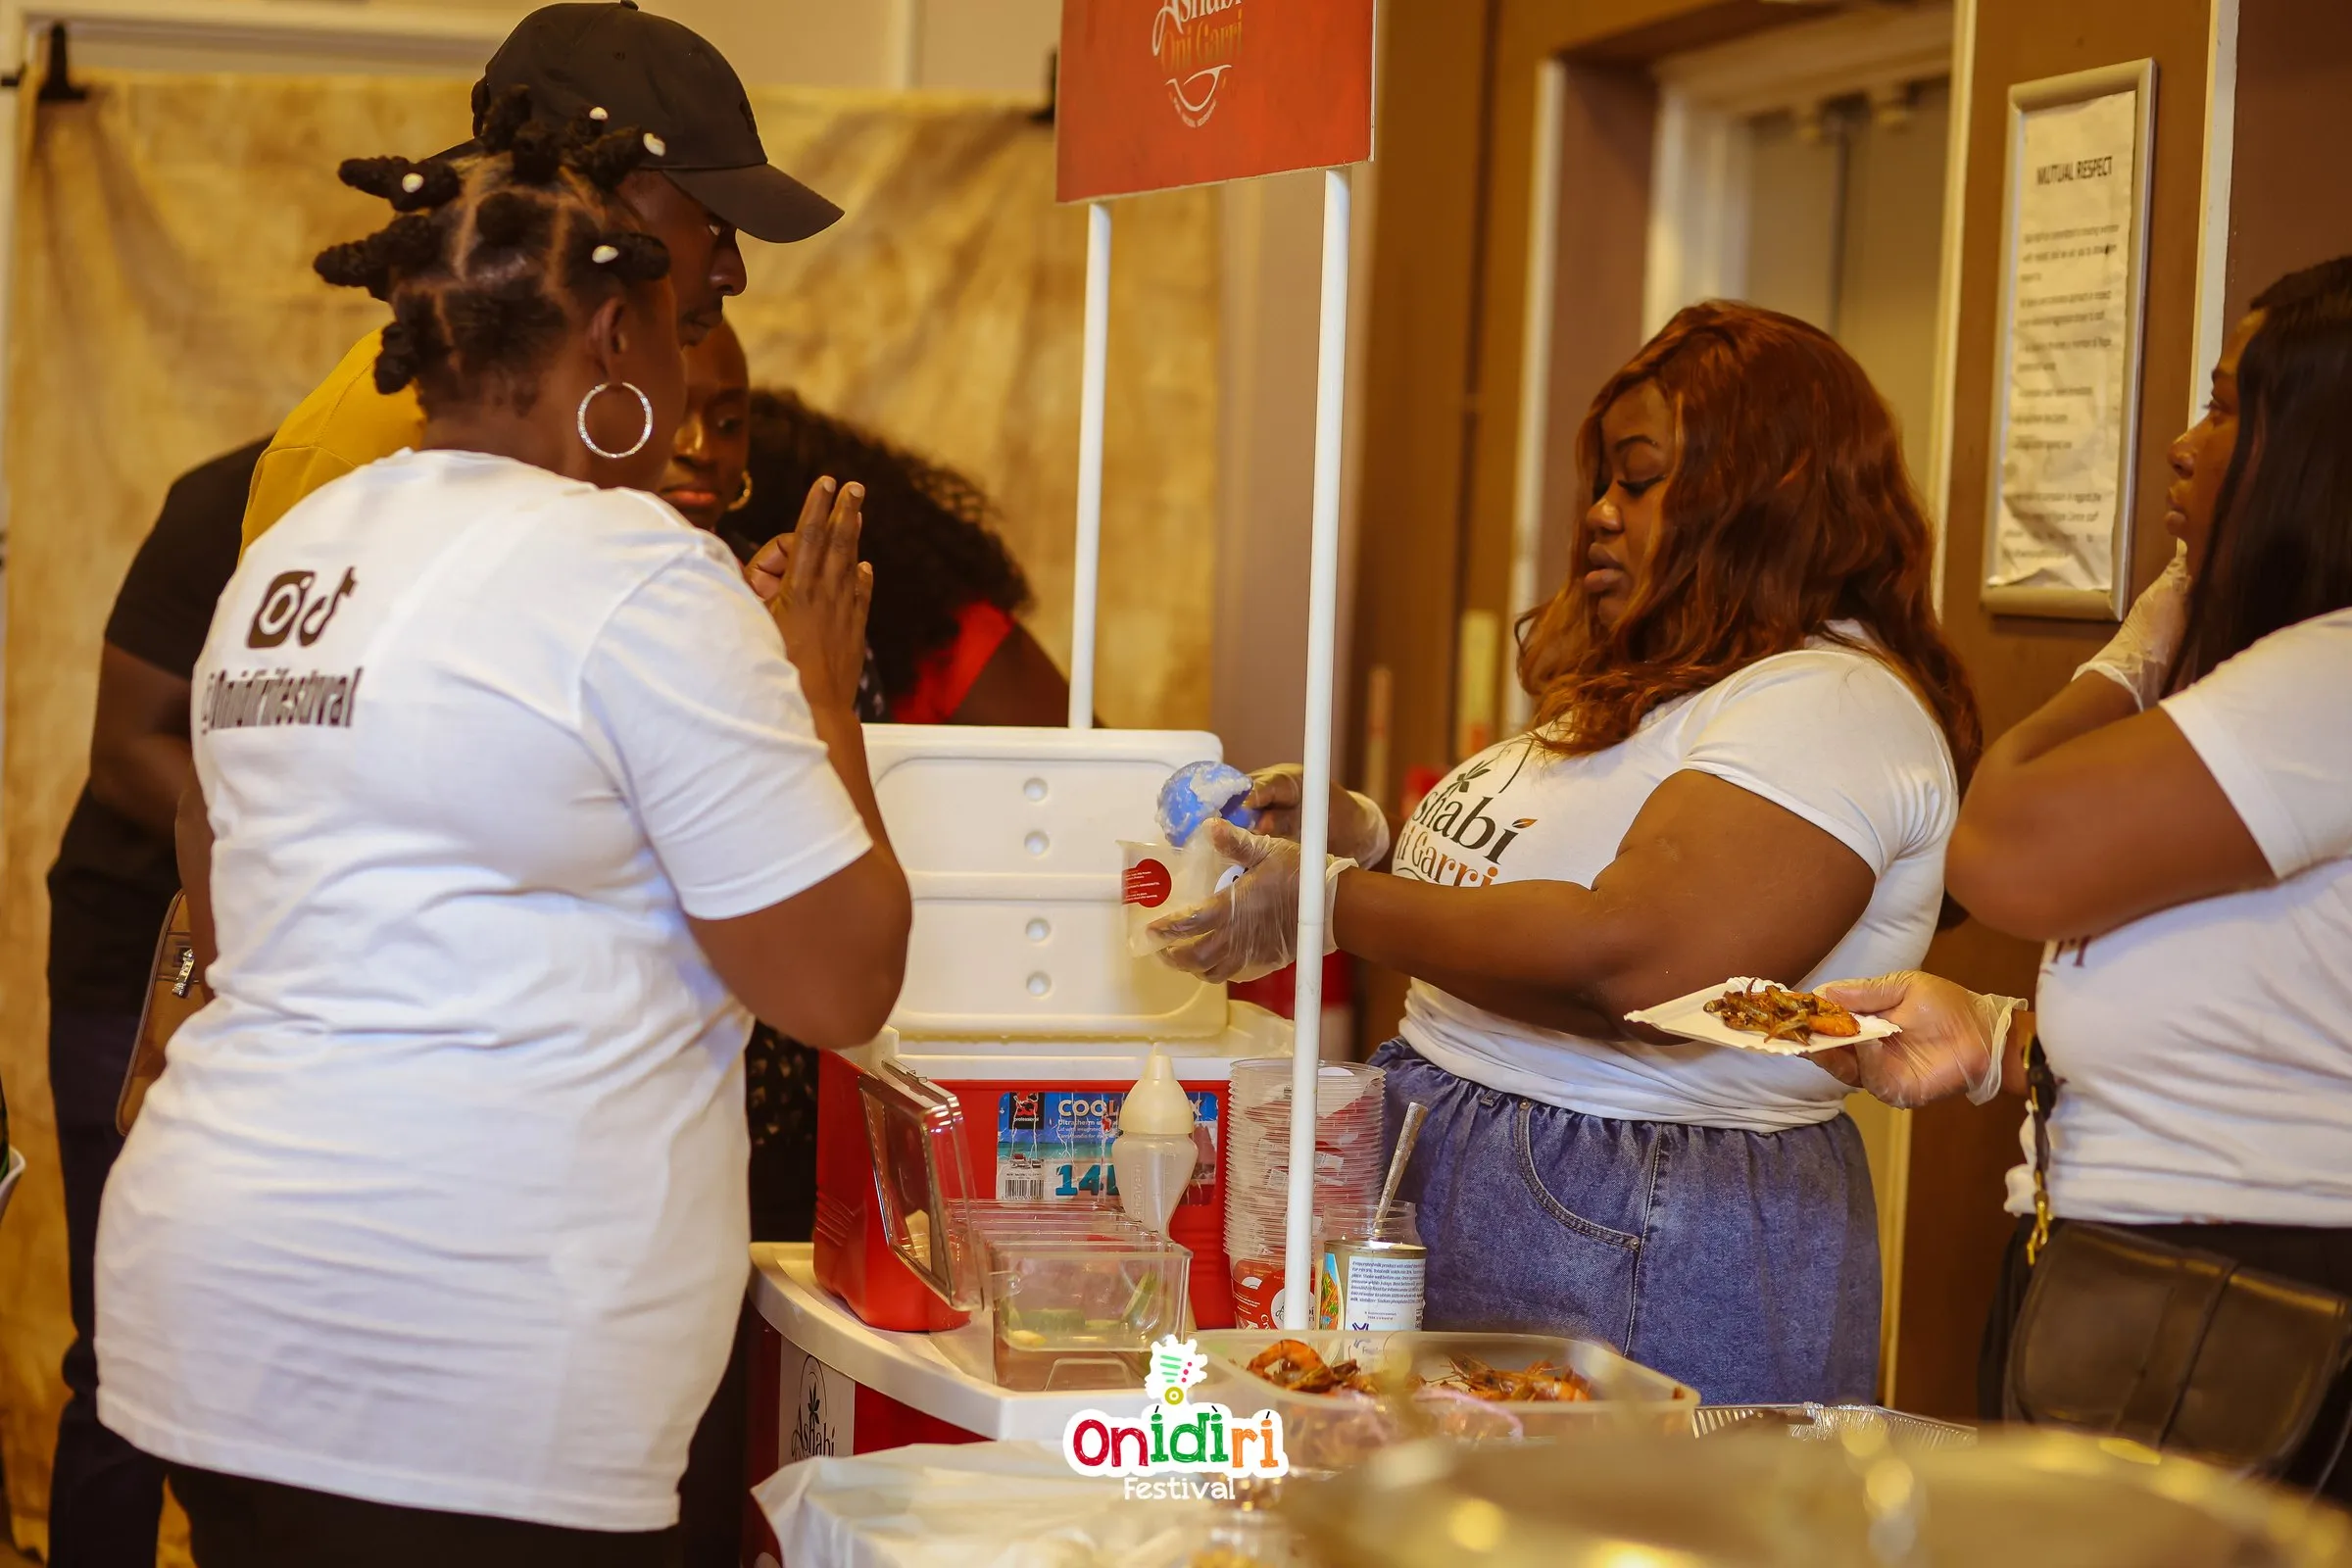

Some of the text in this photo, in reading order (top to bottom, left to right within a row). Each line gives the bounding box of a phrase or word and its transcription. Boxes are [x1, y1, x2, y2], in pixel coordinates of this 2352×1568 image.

[2036, 155, 2112, 185] MUTUAL RESPECT
[1412, 791, 1538, 865] shabi
